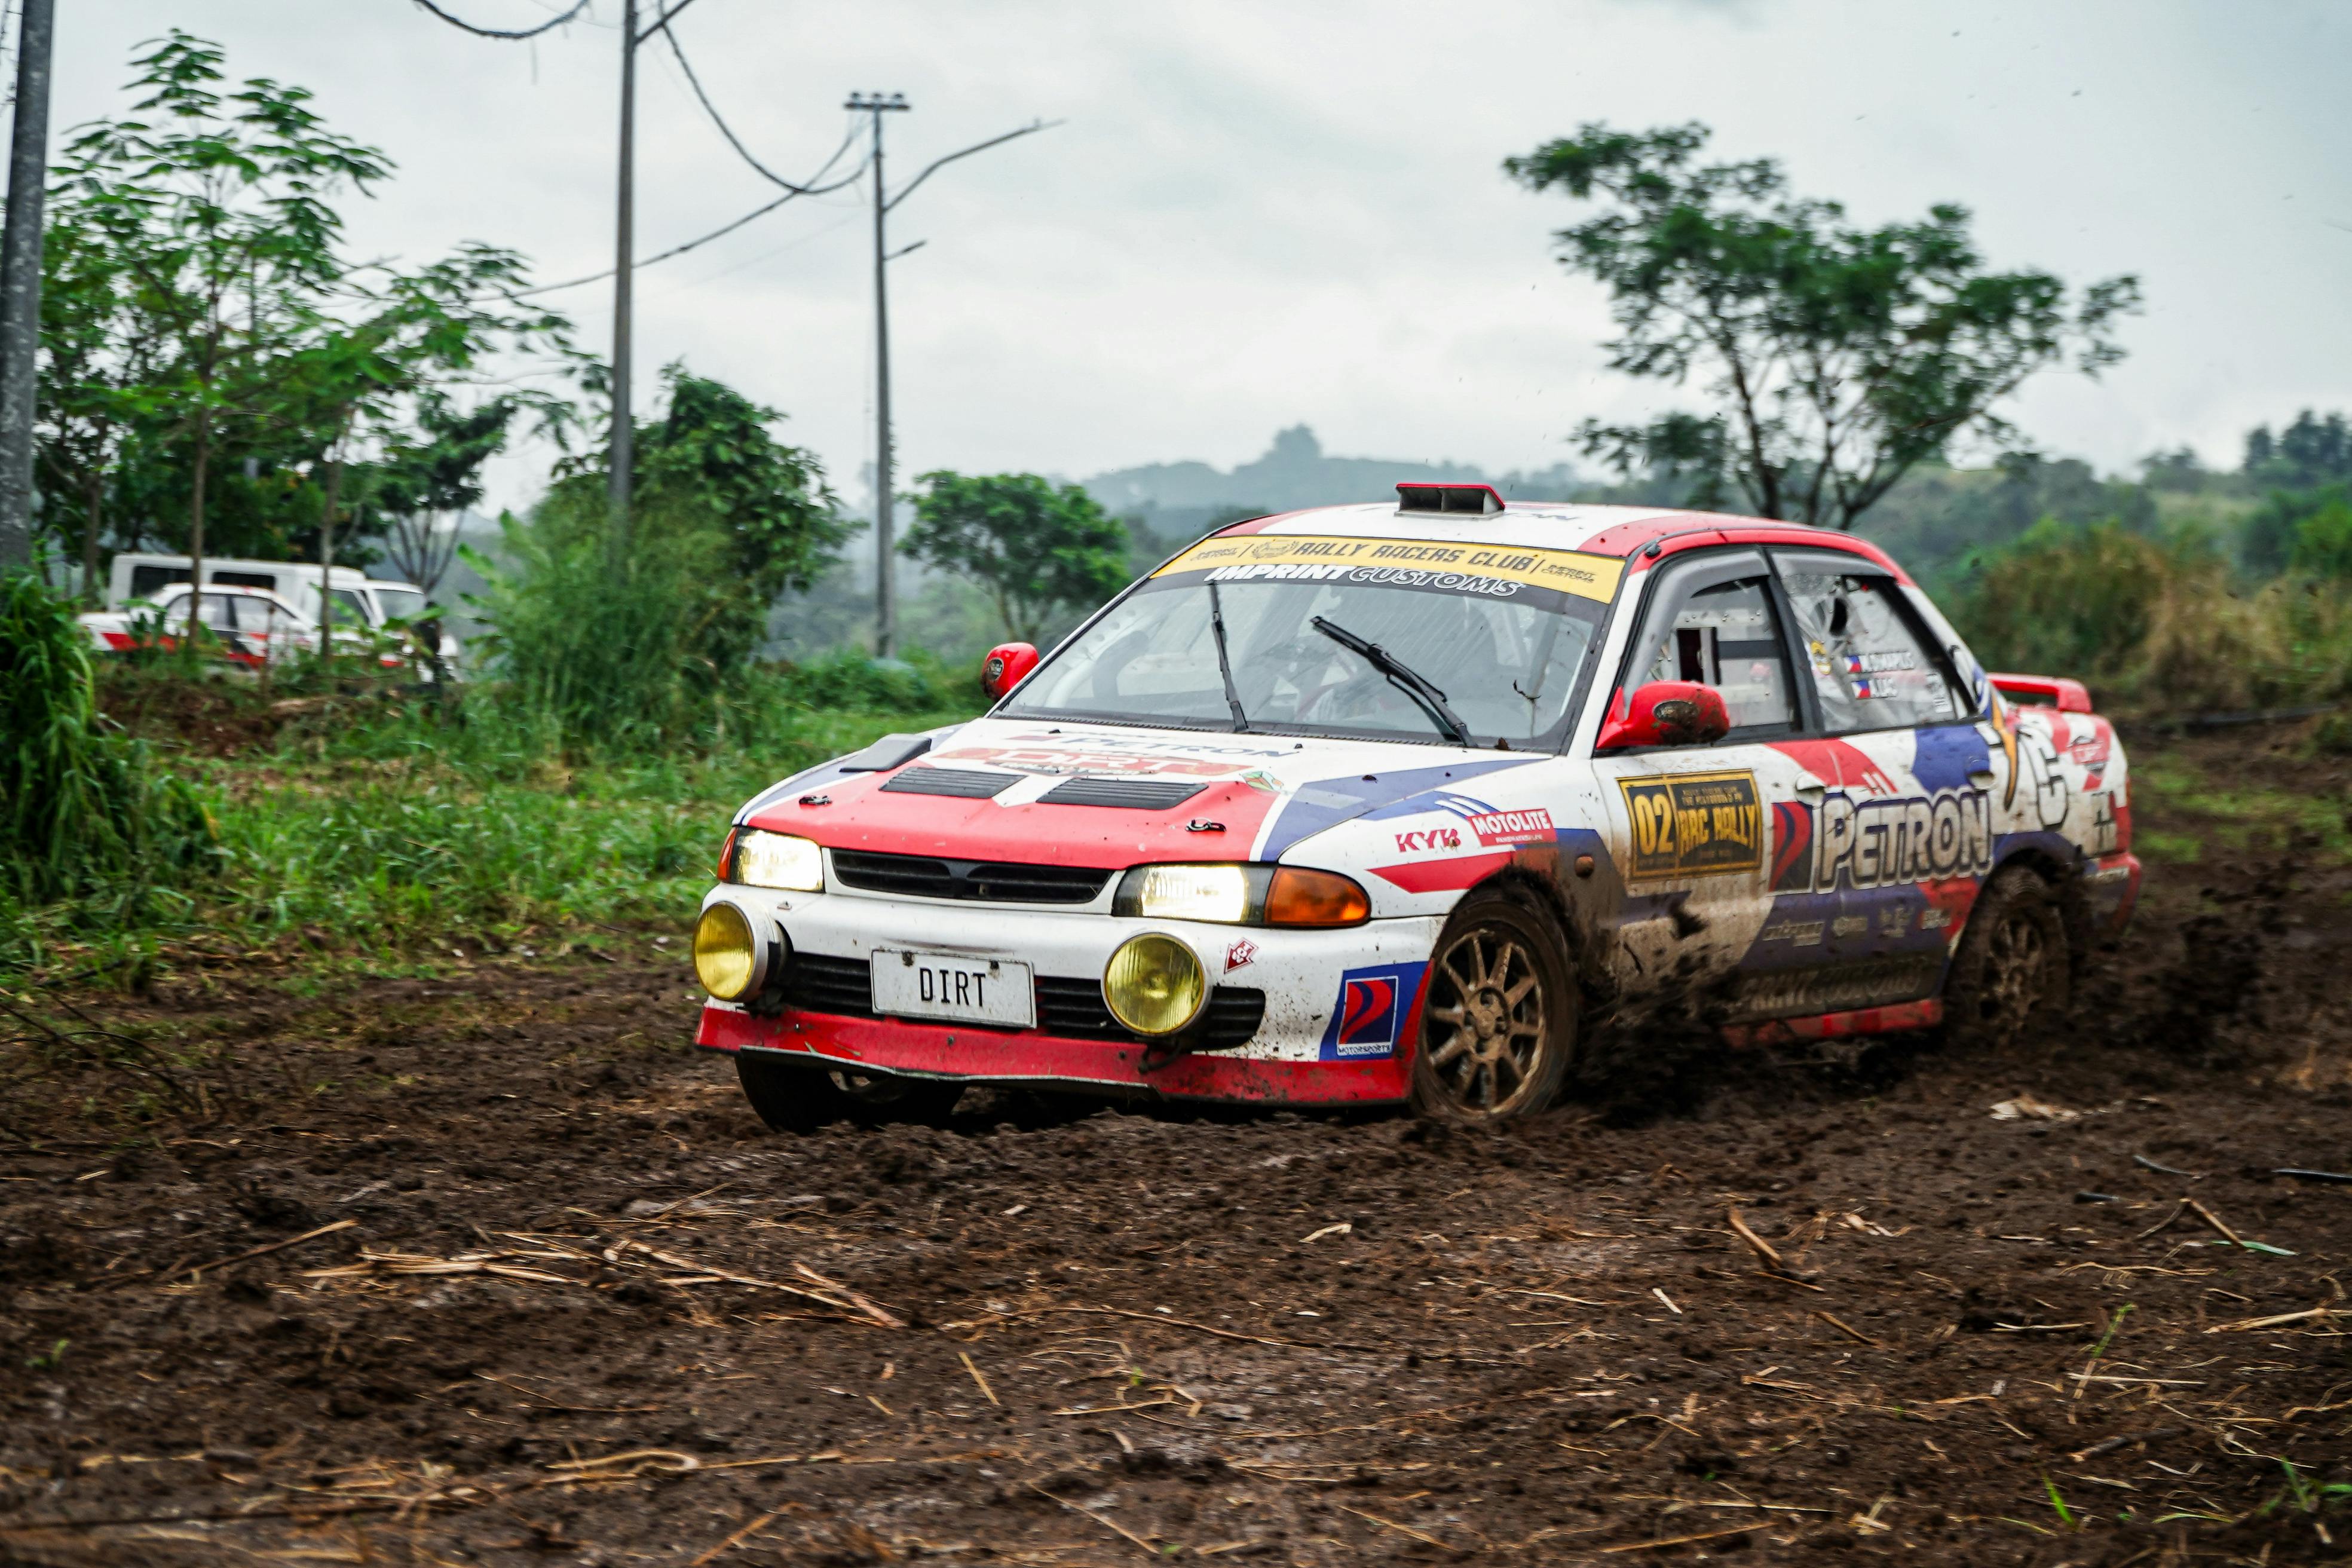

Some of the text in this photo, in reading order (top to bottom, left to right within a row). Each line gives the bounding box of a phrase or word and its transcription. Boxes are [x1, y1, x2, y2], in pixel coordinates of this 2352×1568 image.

[1292, 542, 1370, 558] RALLY
[1370, 545, 1466, 564] RACERS
[1468, 552, 1537, 571] CLUB
[1059, 737, 1300, 758] PETRON
[1471, 811, 1551, 836] MOTOLITE
[1634, 794, 1674, 856] 02
[1713, 804, 1756, 850] RALLY
[1394, 828, 1462, 853] KYB
[1817, 788, 1993, 894] PETRON
[920, 967, 986, 1007] DIRT
